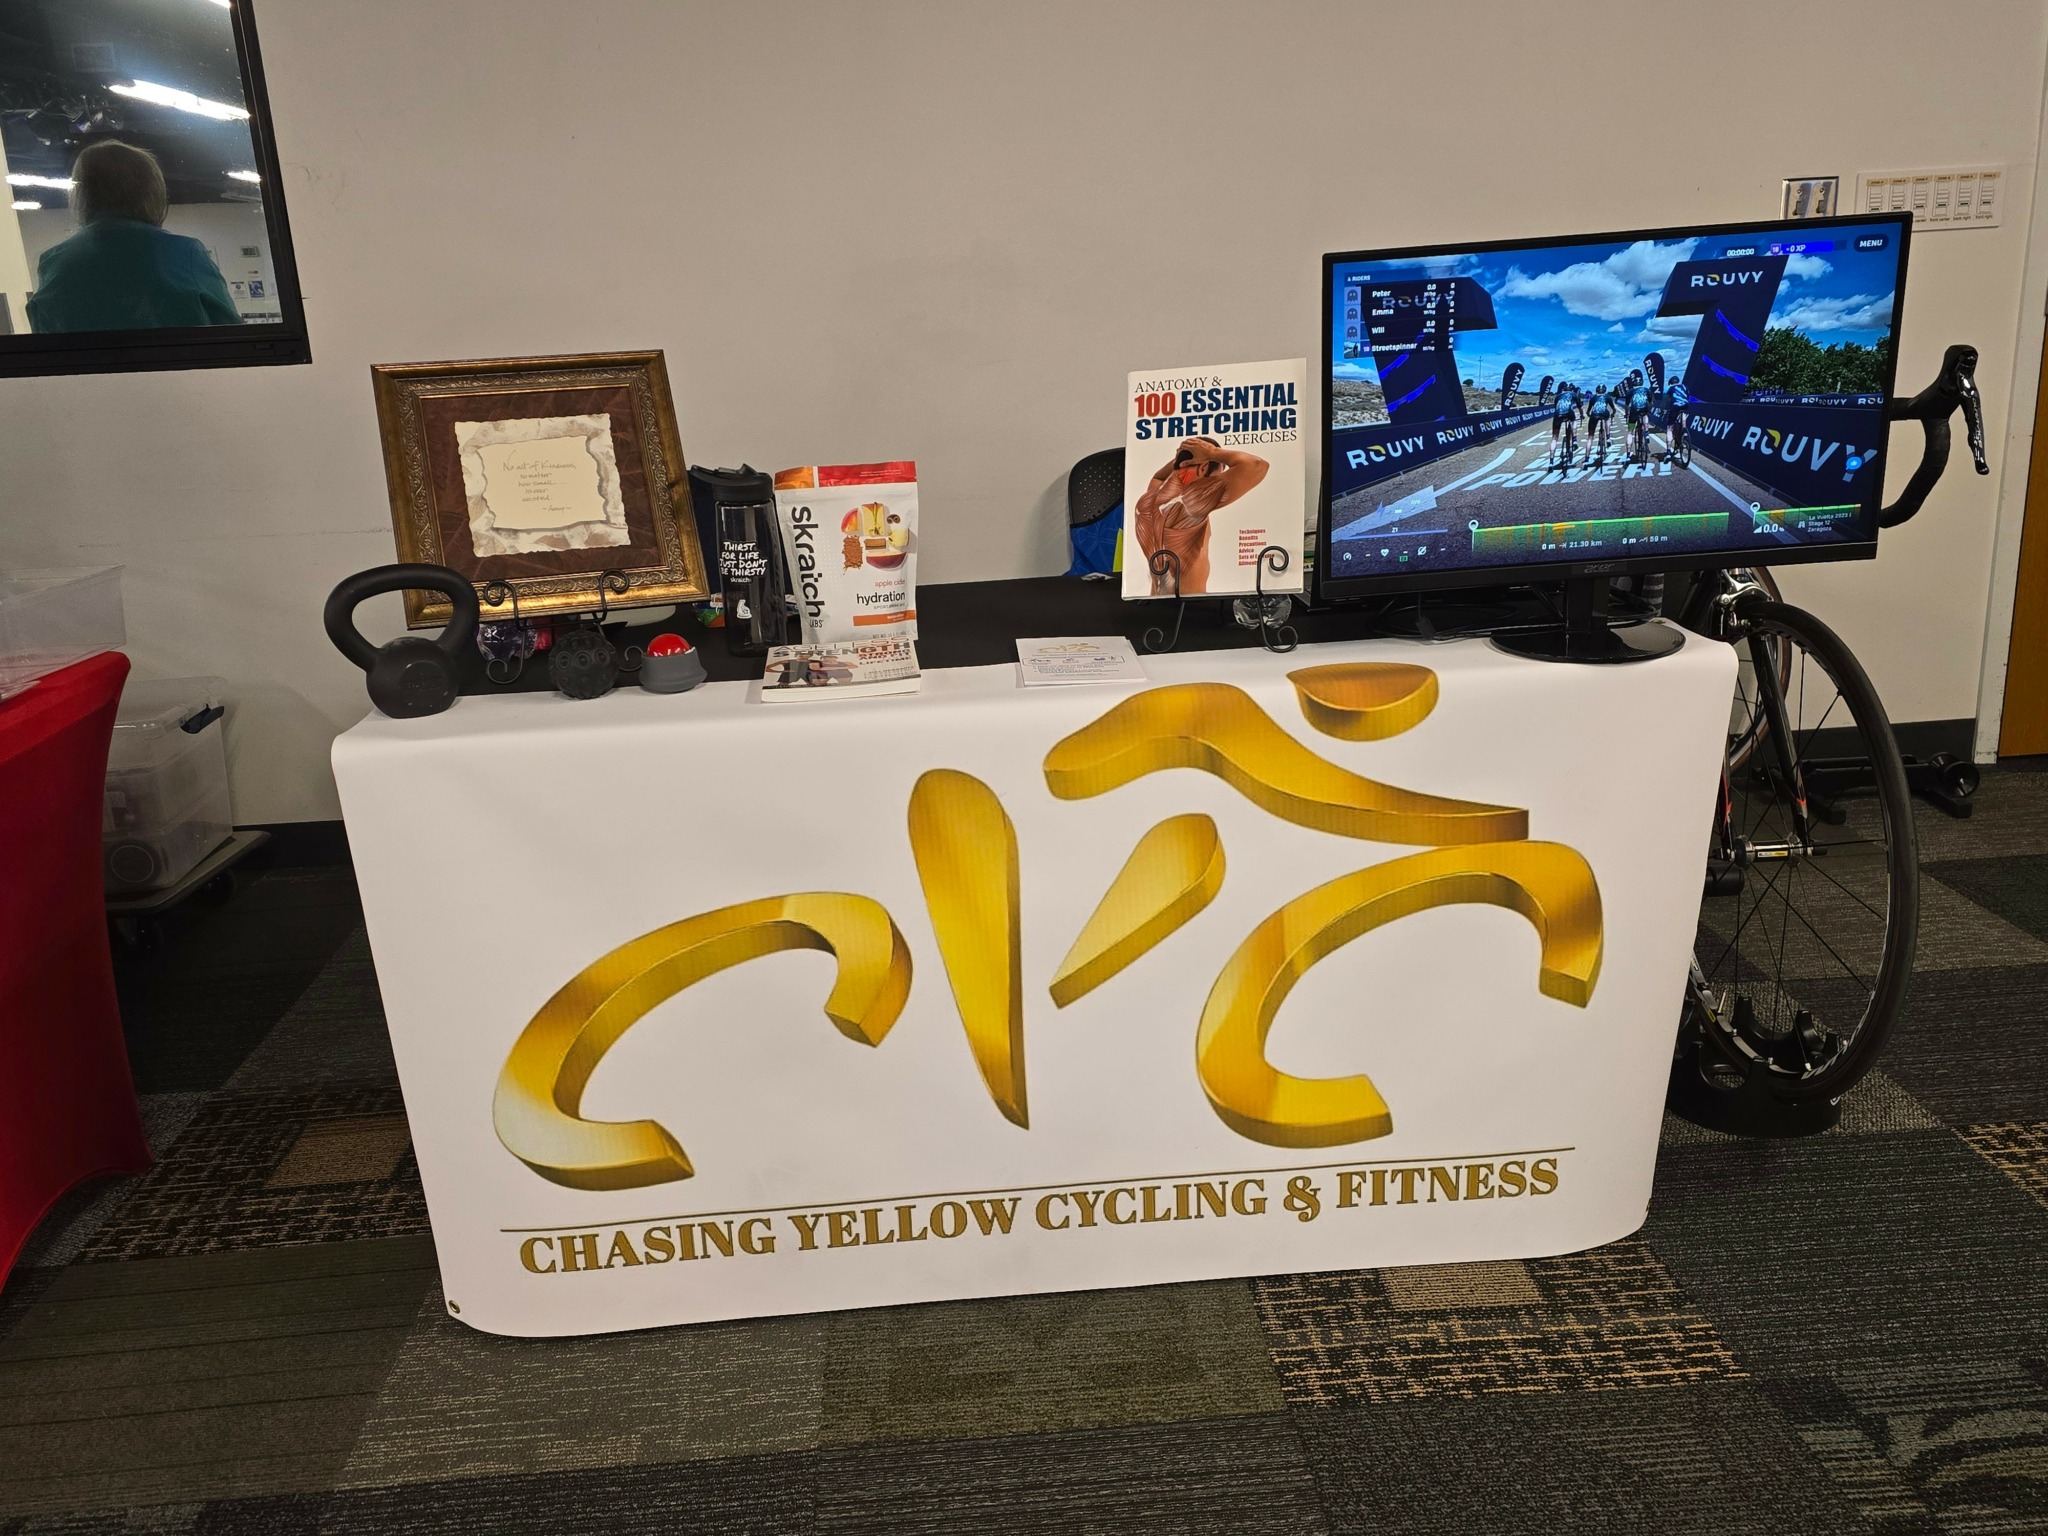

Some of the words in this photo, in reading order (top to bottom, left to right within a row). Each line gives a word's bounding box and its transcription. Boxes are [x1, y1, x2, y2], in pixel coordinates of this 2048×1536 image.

[1796, 244, 1806, 252] XP
[1859, 239, 1883, 247] MENU
[1726, 248, 1755, 257] 00:00:00
[1690, 270, 1764, 287] ROUVY
[1372, 290, 1391, 298] Peter
[1371, 308, 1394, 316] Emma
[1134, 376, 1208, 393] ANATOMY
[1211, 376, 1223, 387] &
[1644, 359, 1661, 395] ROUVY
[1504, 368, 1523, 407] ROUVY
[1134, 392, 1176, 418] 100
[1181, 382, 1298, 414] ESSENTIAL
[1135, 408, 1297, 440] STRETCHING
[1224, 430, 1297, 446] EXERCISES
[1346, 436, 1425, 470] ROUVY
[1436, 424, 1475, 445] ROUVY
[1479, 418, 1503, 433] ROUVY
[1690, 415, 1735, 440] ROUVY
[1742, 425, 1878, 483] ROUVY
[516, 462, 530, 470] act
[1462, 461, 1673, 491] POWER!
[723, 541, 756, 551] THIRST
[1569, 540, 1589, 548] 21.30
[1590, 539, 1602, 547] km
[720, 558, 737, 568] JUST
[739, 558, 768, 568] DON'T
[721, 551, 736, 560] FOR
[739, 551, 760, 560] LIFE
[791, 506, 825, 618] skratch
[721, 567, 729, 575] BE
[730, 567, 766, 576] THIRSTY
[874, 580, 893, 588] apple
[893, 578, 906, 586] cider
[856, 591, 906, 606] hydration
[773, 642, 911, 658] STRENGTH
[519, 1217, 777, 1274] CHASING
[787, 1197, 1022, 1251] YELLOW
[1034, 1178, 1268, 1231] CYCLING
[1283, 1175, 1322, 1223] &
[1336, 1158, 1559, 1209] FITNESS
